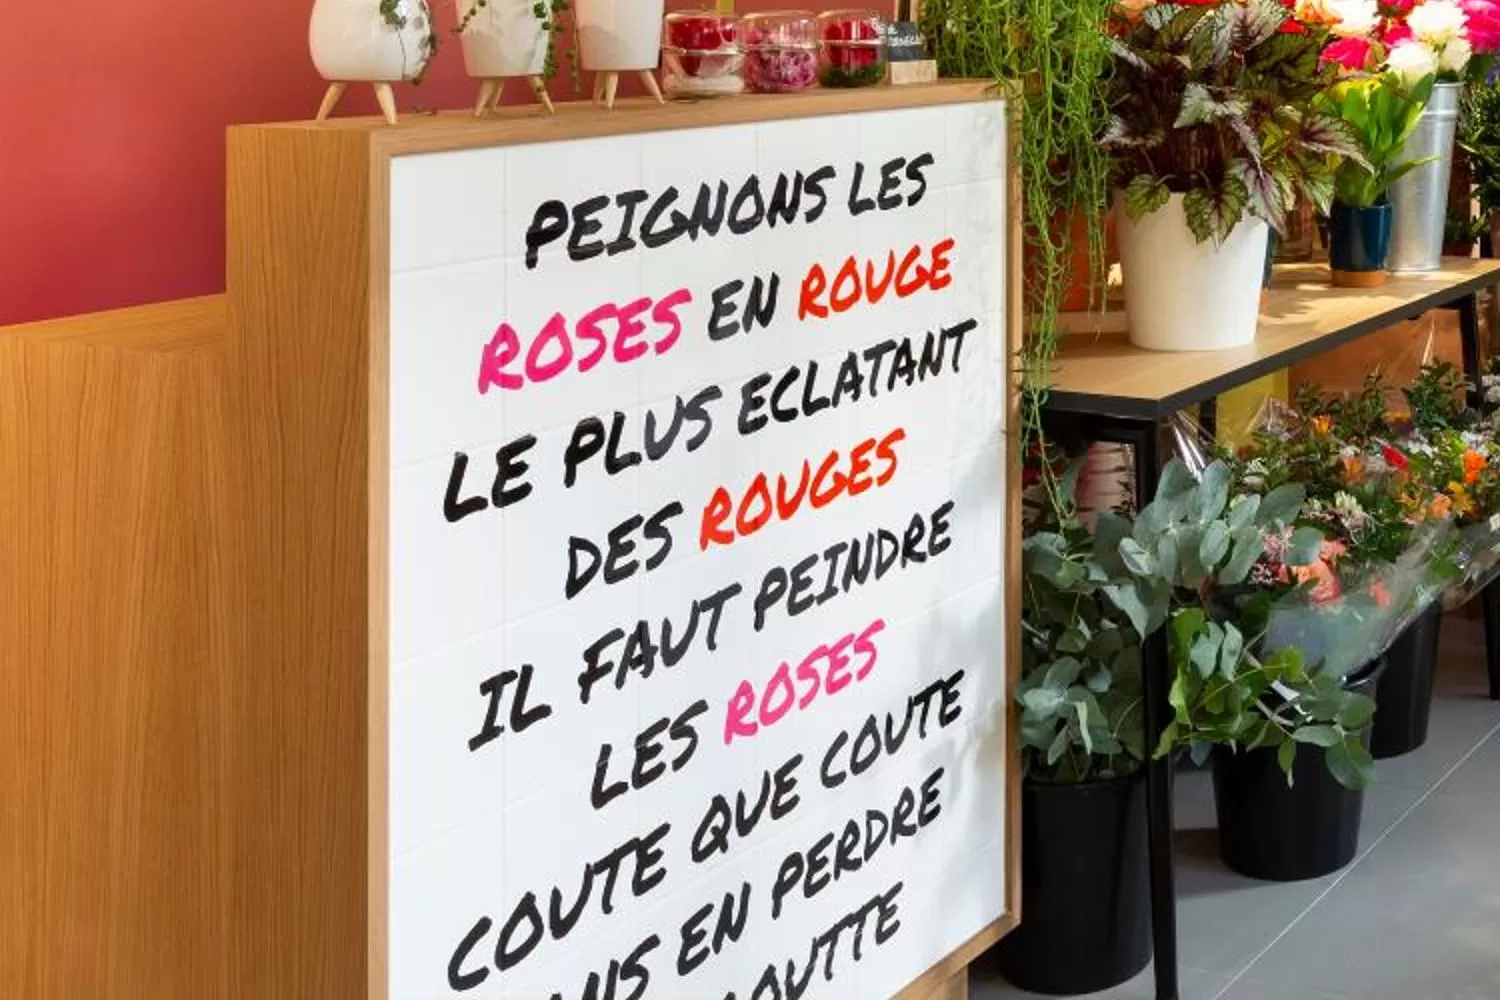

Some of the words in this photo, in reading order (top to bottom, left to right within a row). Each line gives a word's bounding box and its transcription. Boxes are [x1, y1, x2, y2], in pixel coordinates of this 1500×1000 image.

[526, 166, 836, 269] PEIGNONS
[848, 153, 934, 217] LES
[479, 289, 692, 394] ROSES
[708, 272, 779, 340] EN
[799, 239, 954, 320] ROUGE
[444, 435, 536, 522] LE
[564, 386, 722, 488] PLUS
[738, 319, 977, 436] ECLATANT
[566, 502, 683, 600] DES
[700, 428, 906, 550] ROUGES
[469, 665, 552, 751] IL
[578, 583, 742, 704] FAUT
[754, 501, 955, 633] PEINDRE
[591, 700, 708, 809] LES
[725, 620, 885, 744] ROSES
[448, 823, 670, 991] COUTE
[692, 771, 802, 862] QUE
[821, 669, 965, 788] COUTE
[678, 882, 750, 976] EN
[772, 767, 945, 920] PERDRE
[723, 881, 903, 1000] OUTTE
